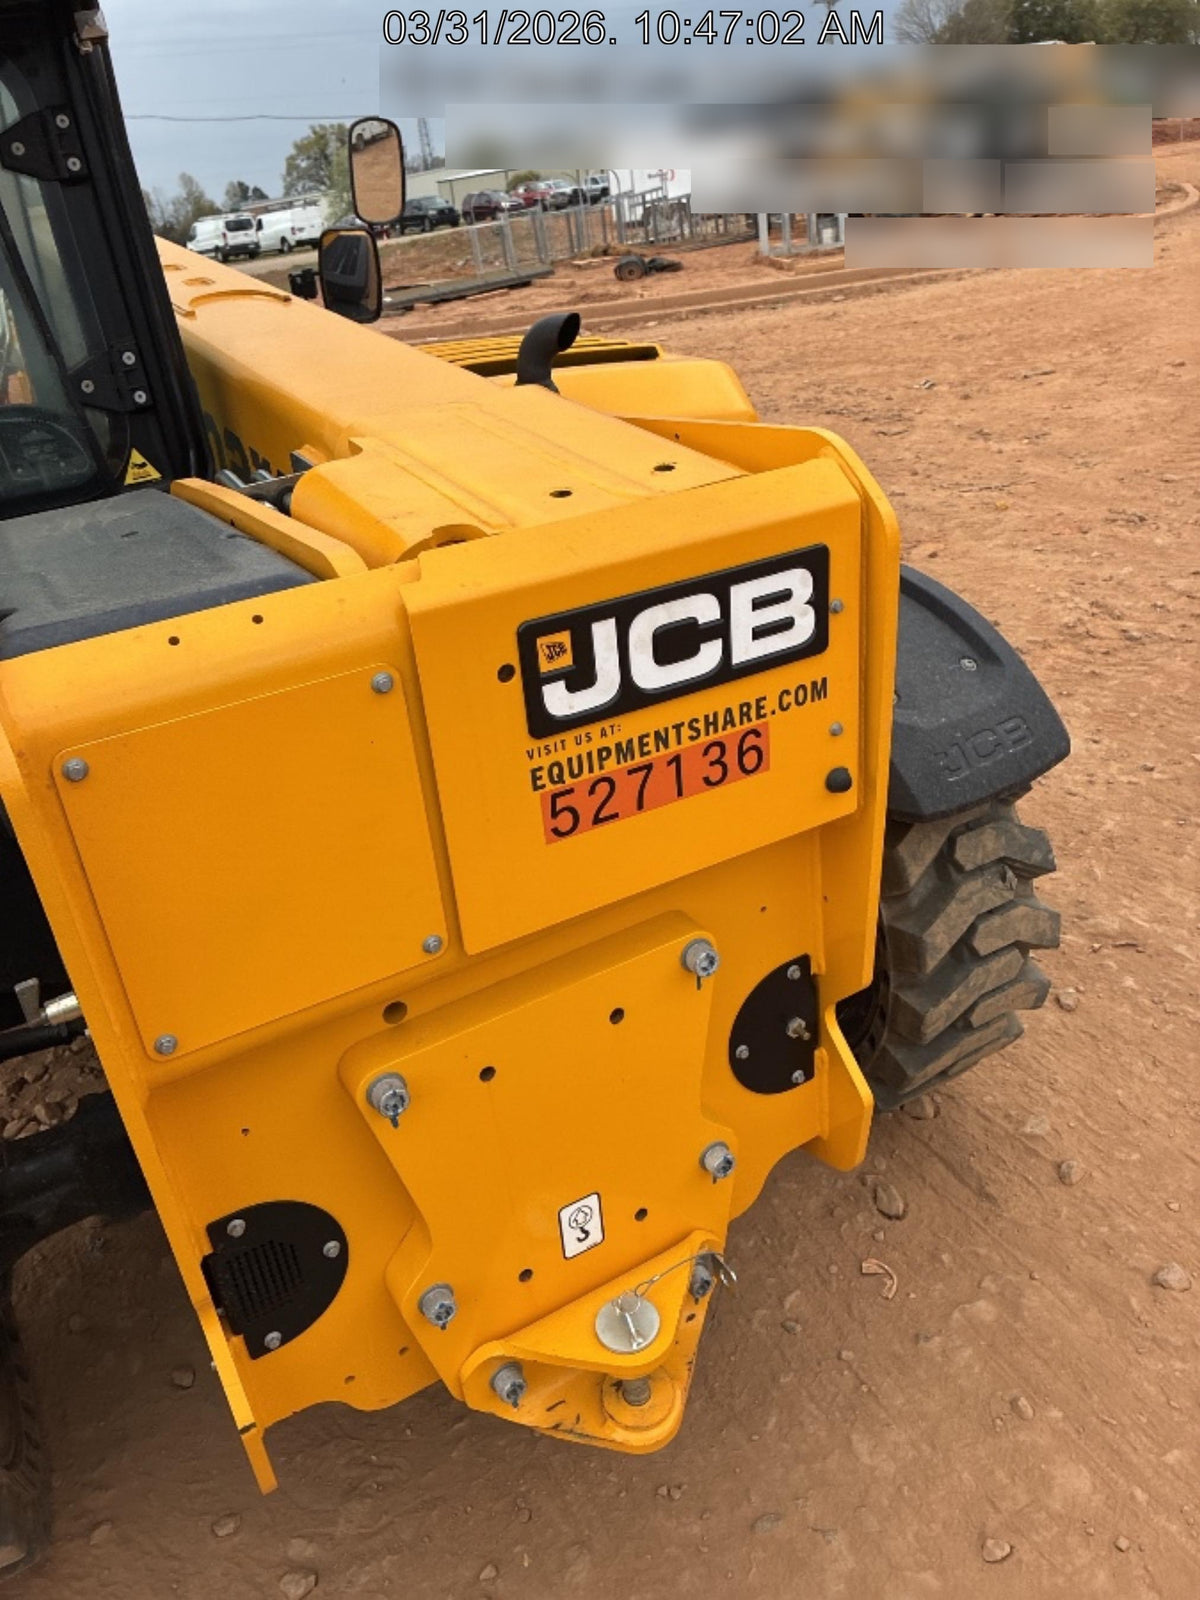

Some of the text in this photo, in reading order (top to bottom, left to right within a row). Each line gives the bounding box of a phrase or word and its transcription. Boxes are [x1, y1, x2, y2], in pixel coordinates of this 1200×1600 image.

[541, 567, 816, 721] JCB
[526, 723, 622, 761] VISIT US AT:
[530, 677, 829, 792] EQUIPMENTSHARE.COM
[550, 728, 764, 839] 527136
[933, 715, 1034, 782] JCB
